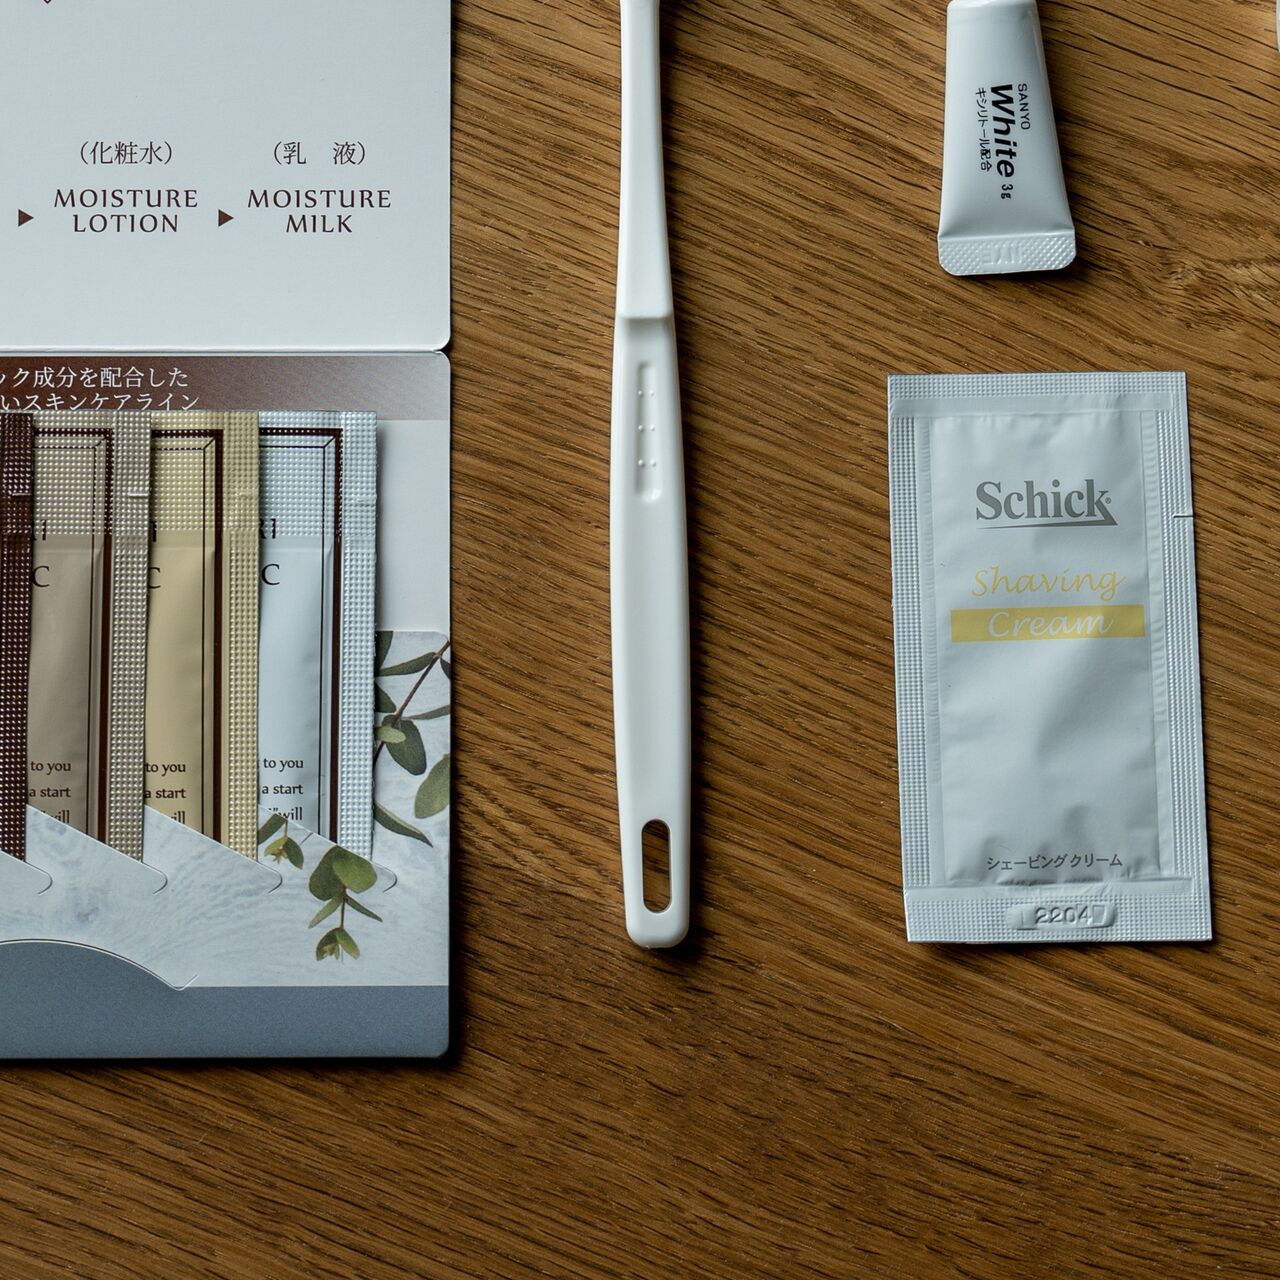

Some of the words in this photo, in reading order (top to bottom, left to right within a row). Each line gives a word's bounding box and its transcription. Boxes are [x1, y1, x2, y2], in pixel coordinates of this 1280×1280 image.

[1017, 83, 1031, 130] SANYO
[976, 87, 993, 172] キシリトール配合
[990, 84, 1018, 178] White
[54, 188, 198, 208] MOISTURE
[247, 189, 391, 209] MOISTURE
[72, 213, 178, 233] LOTION
[286, 214, 353, 233] MILK
[971, 565, 1127, 602] Shaving
[988, 611, 1114, 638] Cream
[31, 760, 44, 771] to
[47, 761, 70, 776] you
[145, 761, 159, 772] to
[162, 762, 185, 776] you
[263, 757, 277, 768] to
[279, 758, 303, 773] you
[29, 787, 36, 798] a
[40, 786, 71, 797] start
[144, 789, 151, 800] a
[155, 787, 186, 799] start
[261, 784, 269, 795] a
[273, 783, 303, 794] start
